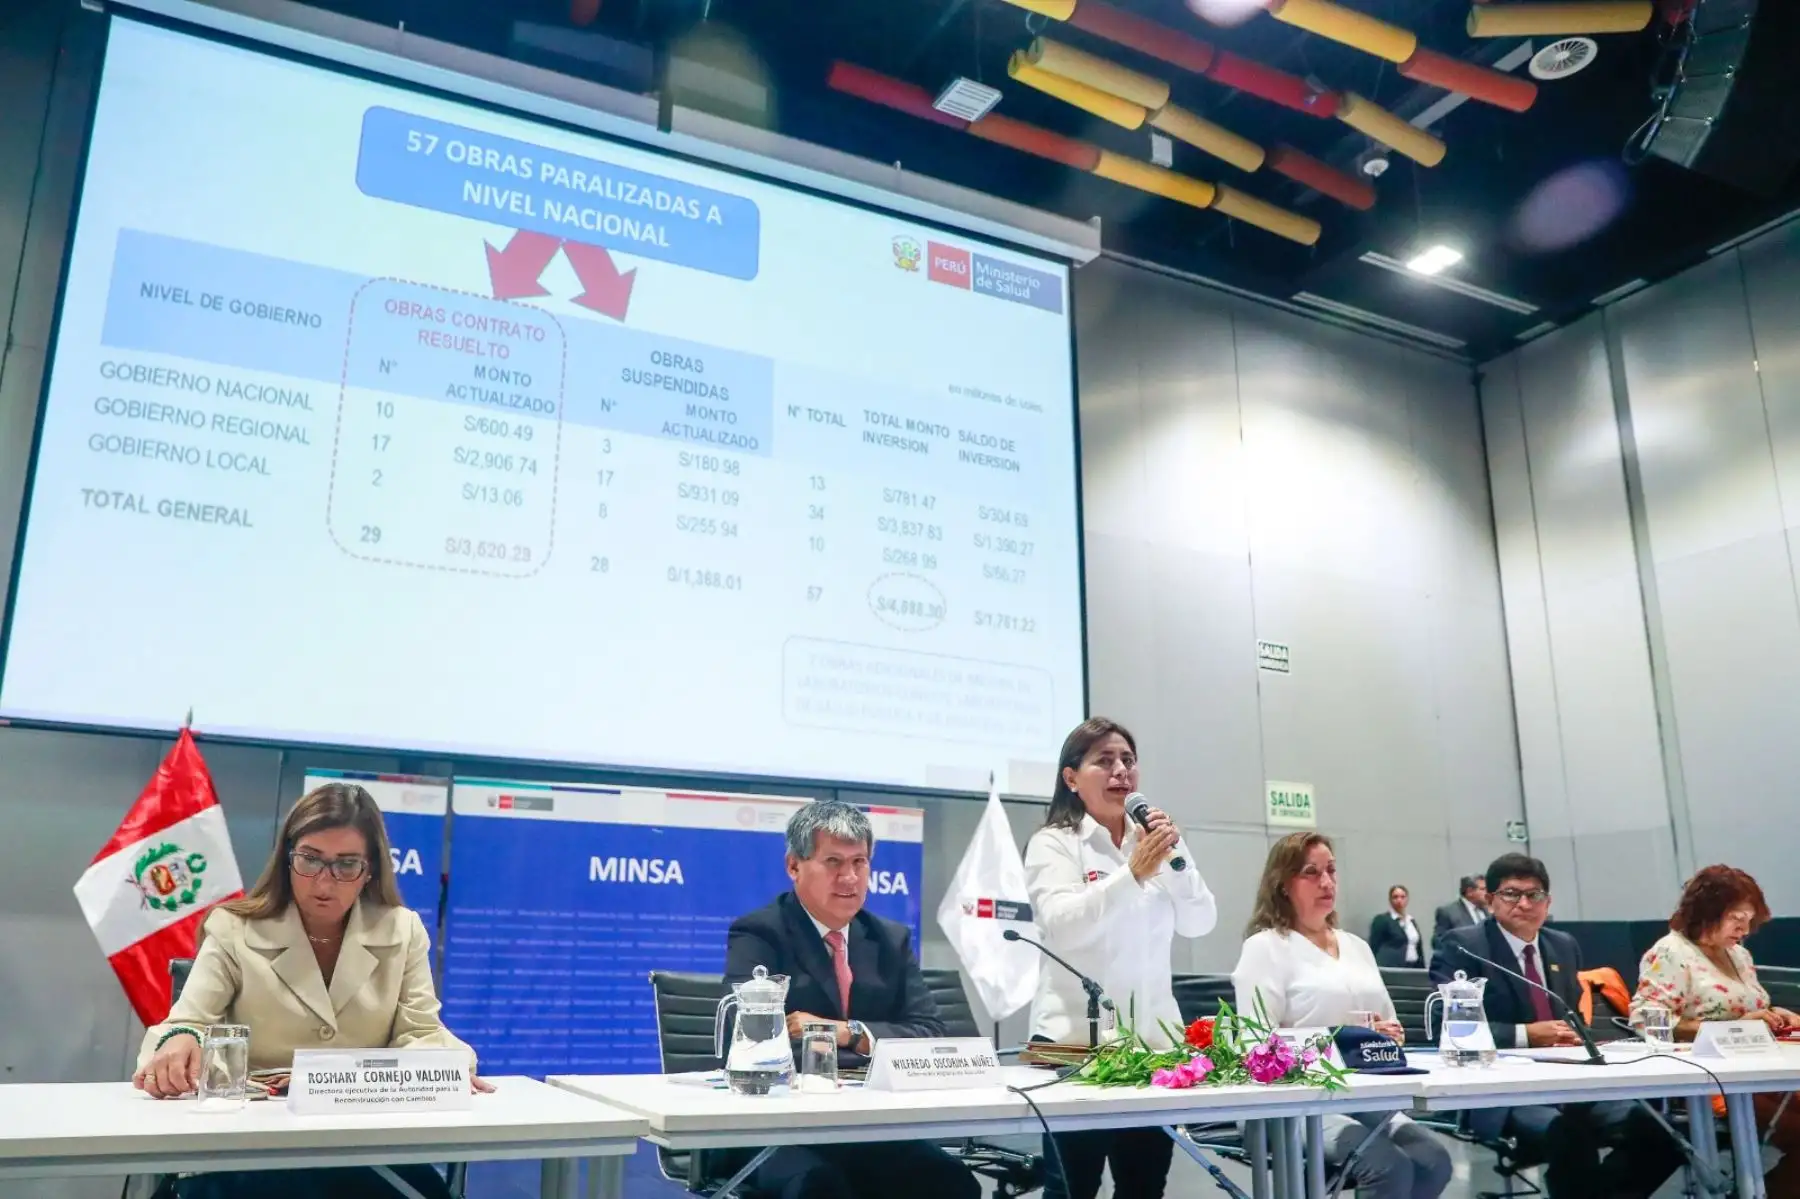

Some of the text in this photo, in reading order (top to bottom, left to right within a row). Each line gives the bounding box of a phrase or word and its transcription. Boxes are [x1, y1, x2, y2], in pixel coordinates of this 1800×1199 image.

[407, 130, 723, 226] 57 OBRAS PARALIZADAS A
[462, 180, 670, 247] NIVEL NACIONAL
[934, 256, 967, 275] PERÚ
[976, 261, 1041, 289] Ministerio
[976, 276, 1031, 299] de Salud
[140, 281, 322, 329] NIVEL DE GOBIERNO
[385, 299, 545, 342] OBRAS CONTRATO
[417, 330, 510, 360] RESUELTO
[650, 351, 704, 373] OBRAS
[100, 360, 314, 411] GOBIERNO NACIONAL
[474, 364, 532, 387] MONTO
[621, 368, 730, 401] SUSPENDIDAS
[376, 400, 394, 418] 10
[445, 383, 555, 415] ACTUALIZADO
[94, 397, 311, 445] GOBIERNO REGIONAL
[685, 403, 738, 425] MONTO
[807, 408, 847, 428] TOTAL
[864, 410, 950, 440] TOTAL MONTO
[372, 434, 391, 452] 17
[601, 438, 612, 454] 3
[661, 421, 759, 451] ACTUALIZADO
[863, 431, 929, 455] INVERSION
[959, 429, 1016, 452] SALDO DE
[88, 433, 272, 476] GOBIERNO LOCAL
[959, 450, 1020, 473] INVERSION
[372, 469, 383, 487] 2
[597, 469, 614, 487] 17
[809, 475, 826, 491] 13
[81, 488, 254, 528] TOTAL GENERAL
[598, 502, 608, 519] 8
[809, 505, 825, 520] 34
[360, 525, 382, 543] 29
[809, 536, 825, 552] 10
[590, 556, 609, 573] 28
[807, 586, 822, 602] 57
[1270, 790, 1311, 809] SALIDA
[589, 856, 684, 885] MINSA
[867, 871, 909, 895] NSA
[892, 1058, 931, 1070] WILFREDO
[1362, 1047, 1400, 1062] Salud
[308, 1069, 462, 1085] ROSMARY CORNEJO VALDIVIA
[308, 1087, 343, 1096] Directora
[379, 1086, 389, 1094] de
